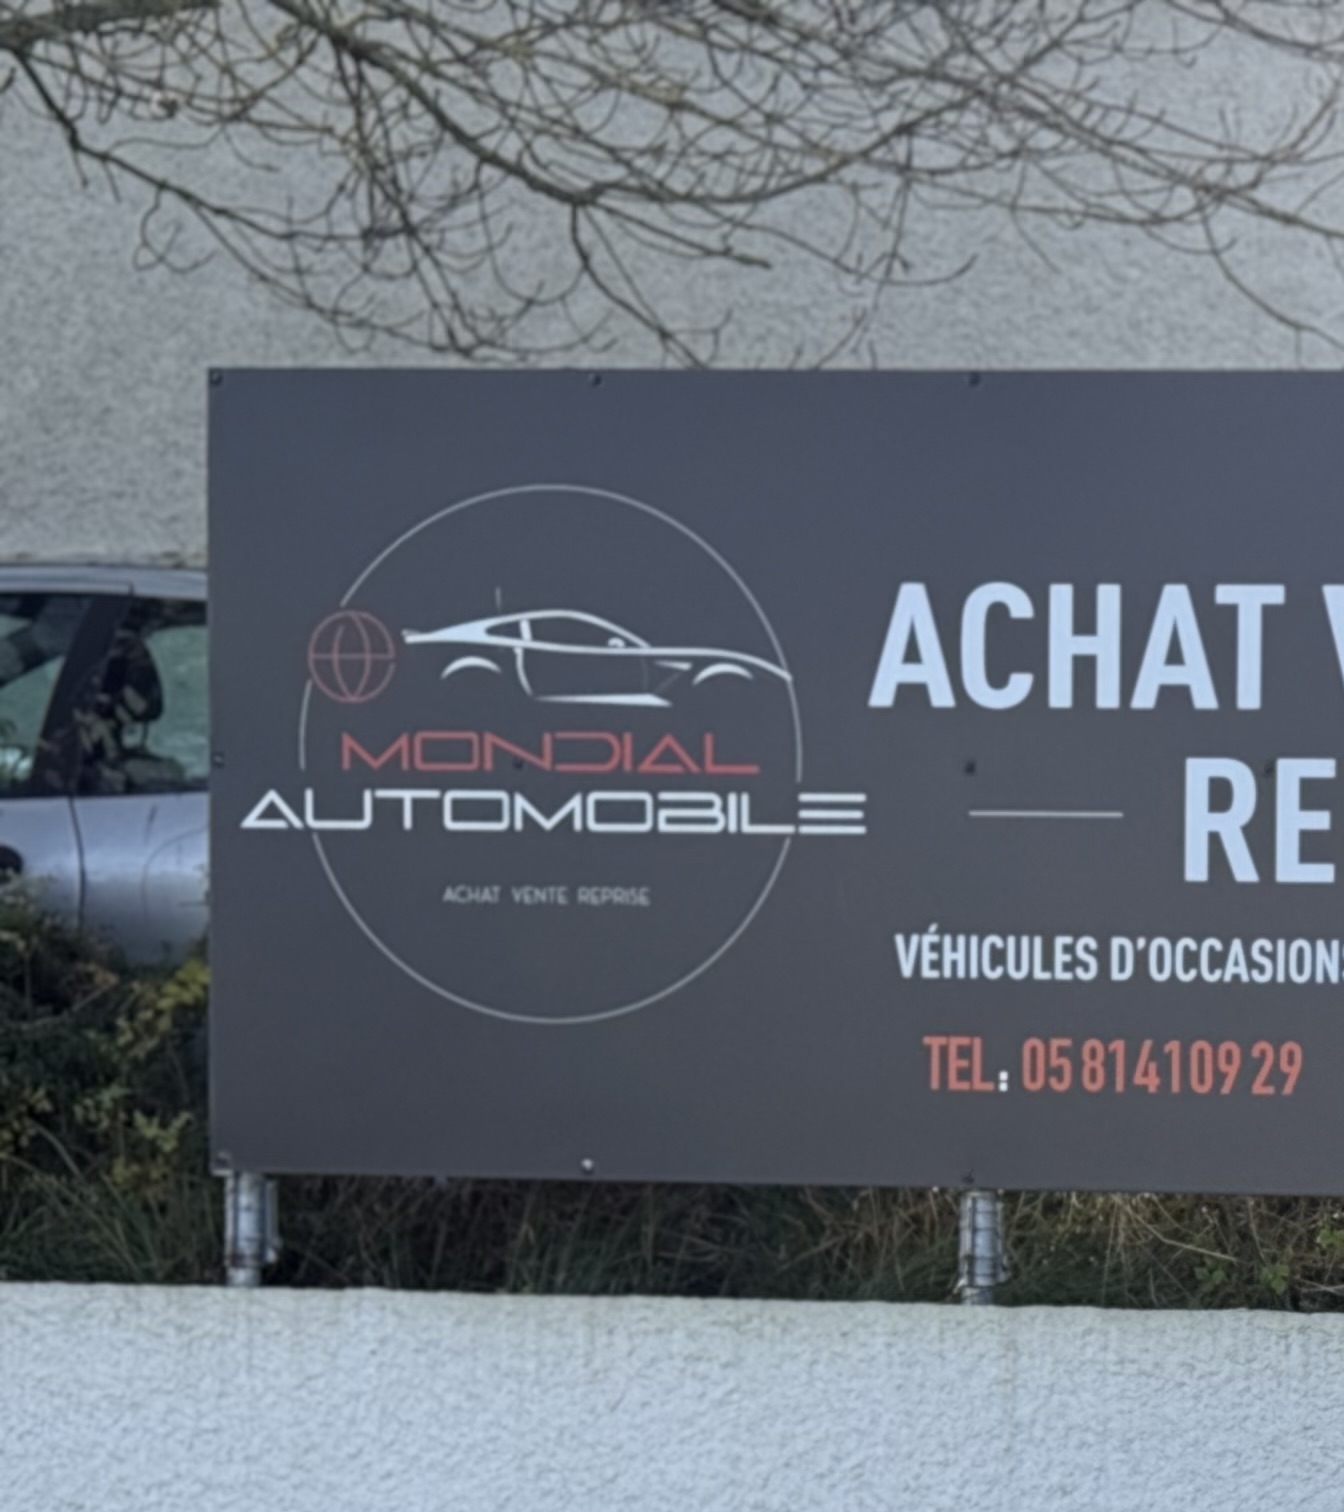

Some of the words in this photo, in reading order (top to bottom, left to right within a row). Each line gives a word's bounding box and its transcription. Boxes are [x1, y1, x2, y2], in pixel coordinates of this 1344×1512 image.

[868, 581, 1286, 710] ACHAT
[342, 731, 761, 775] MONDIAL
[240, 788, 867, 835] AUTOMOBILE
[443, 885, 500, 903] ACHAT
[512, 886, 567, 905] VENTE
[577, 886, 650, 906] REPRISE
[894, 923, 1098, 982] VÉHICULES
